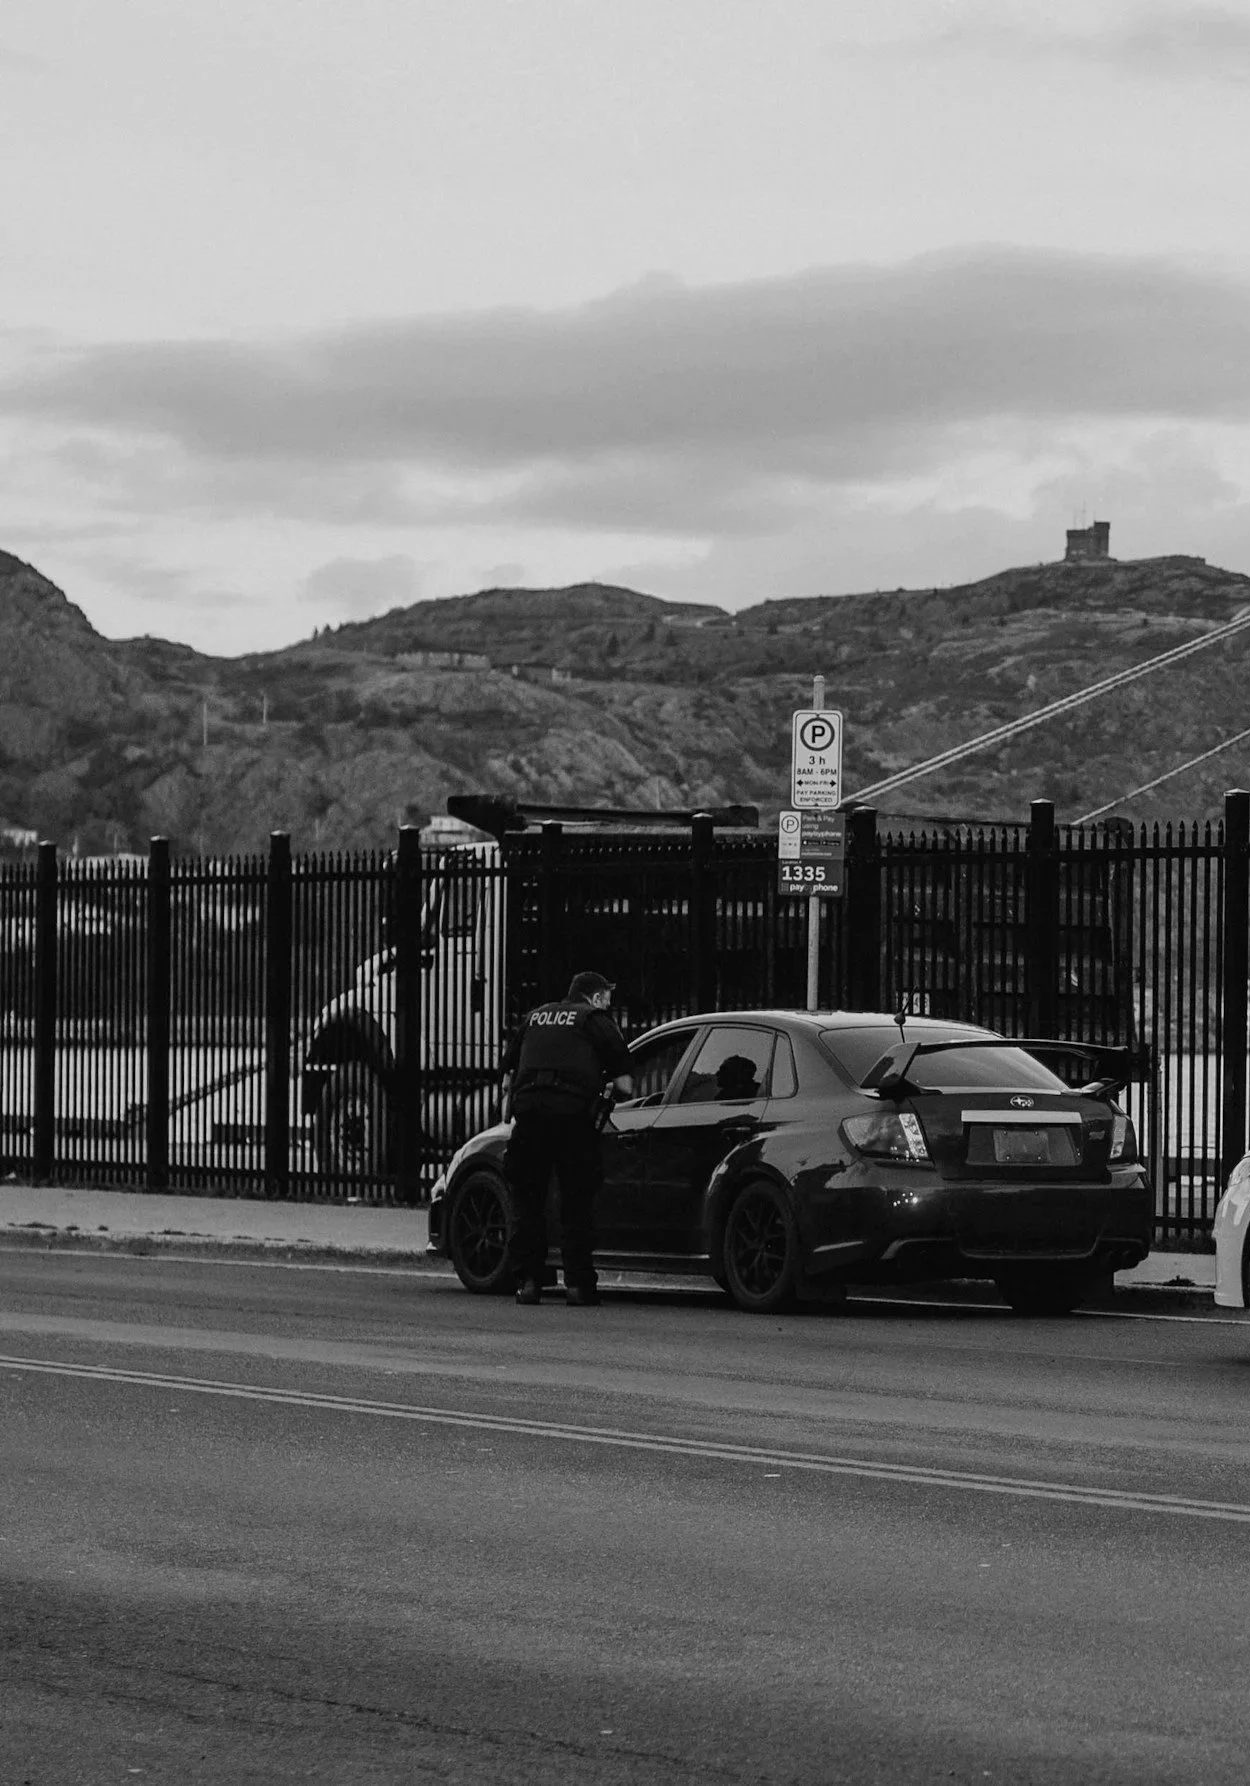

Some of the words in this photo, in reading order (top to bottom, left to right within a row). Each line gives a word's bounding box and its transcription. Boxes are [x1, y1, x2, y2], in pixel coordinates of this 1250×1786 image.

[811, 725, 825, 744] P
[808, 755, 816, 765] 3
[818, 755, 826, 765] h
[786, 819, 795, 830] P
[782, 865, 826, 882] 1335
[529, 1010, 578, 1027] POLICE
